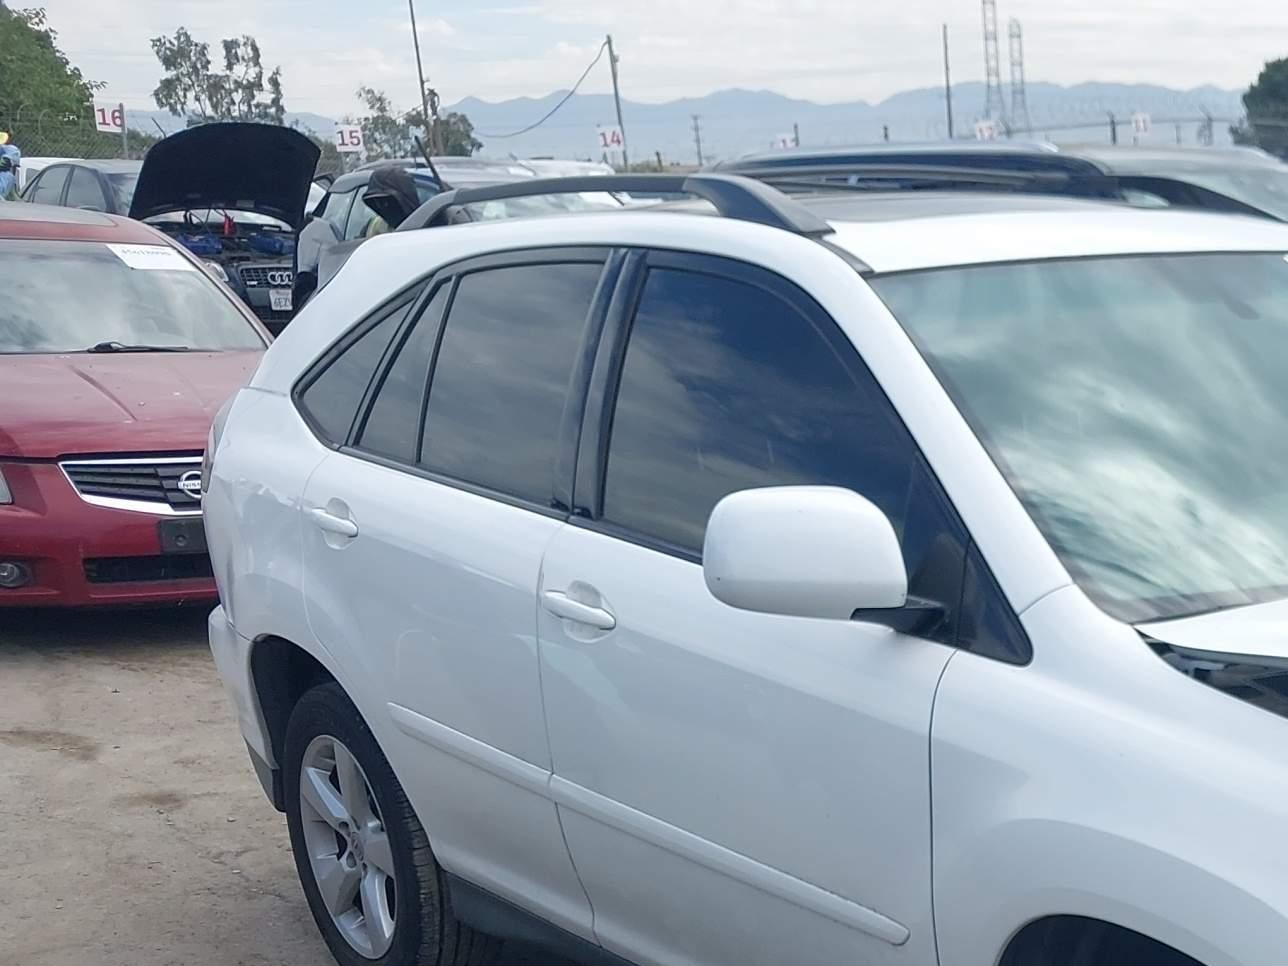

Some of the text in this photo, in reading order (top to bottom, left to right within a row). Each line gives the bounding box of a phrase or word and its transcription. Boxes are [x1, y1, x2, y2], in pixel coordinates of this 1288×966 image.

[96, 107, 122, 127] 16
[336, 129, 361, 146] 15
[599, 130, 622, 147] 14
